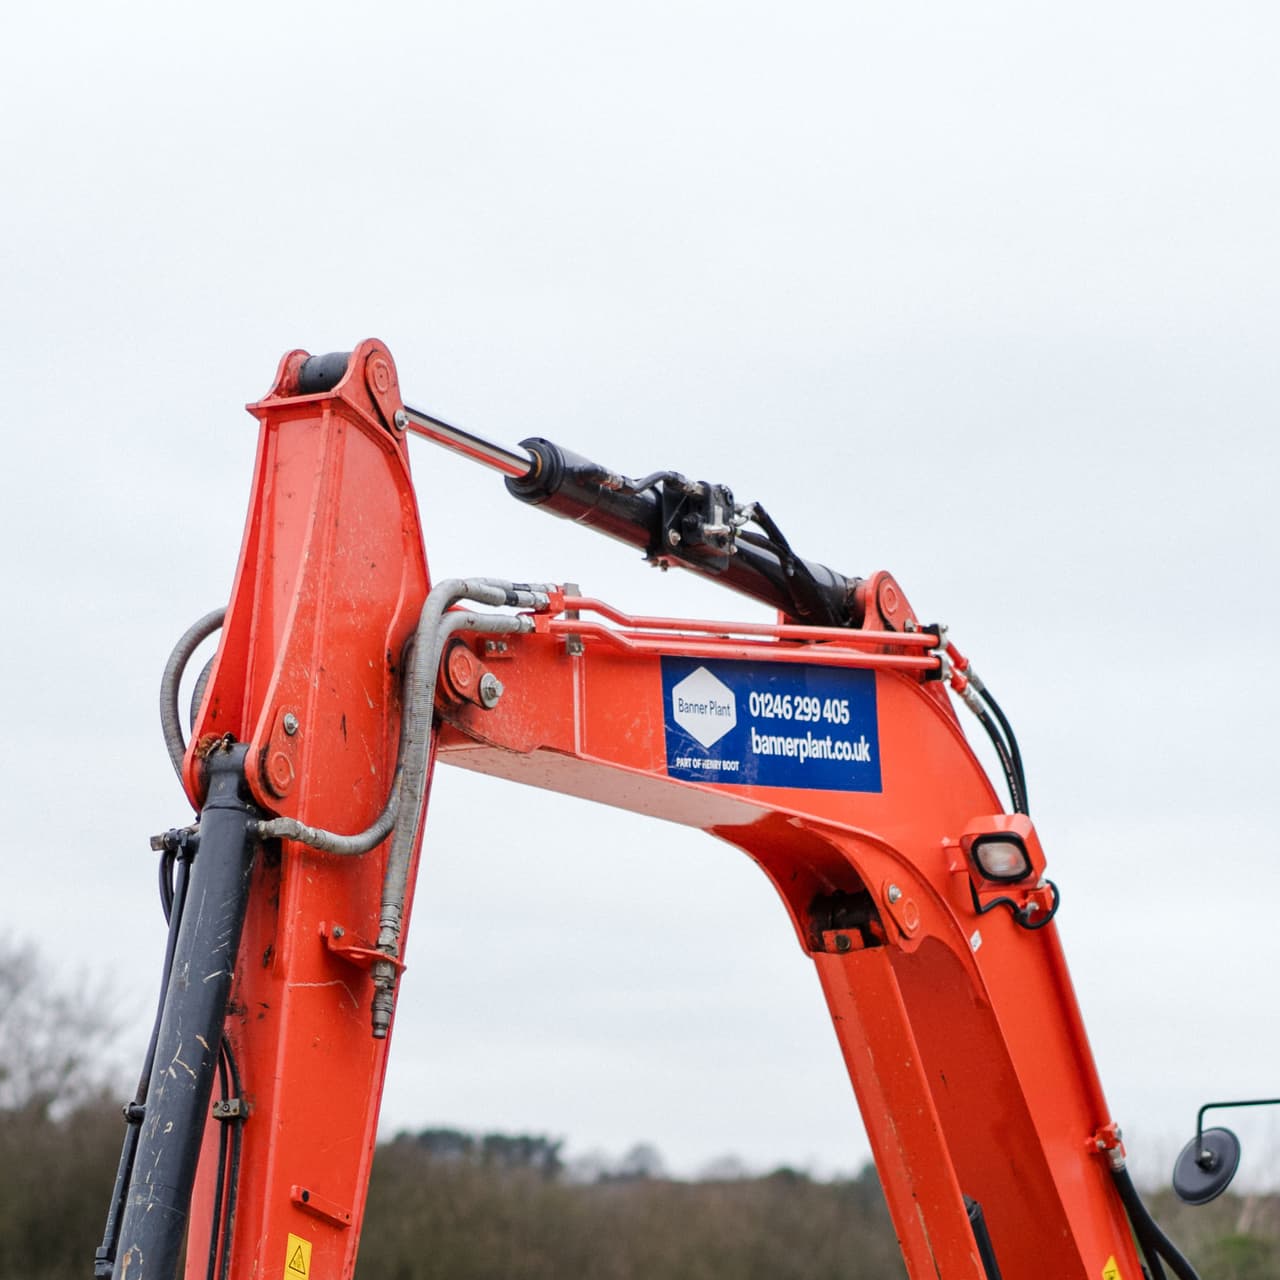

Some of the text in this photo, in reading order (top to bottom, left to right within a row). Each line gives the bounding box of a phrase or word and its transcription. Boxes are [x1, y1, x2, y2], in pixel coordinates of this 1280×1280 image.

[678, 697, 731, 717] Banner Plant
[749, 691, 850, 725] 01246 299 405
[751, 726, 871, 764] bannerplant.co.uk
[676, 757, 692, 768] PART
[692, 758, 701, 769] OF
[722, 760, 740, 771] BOOT
